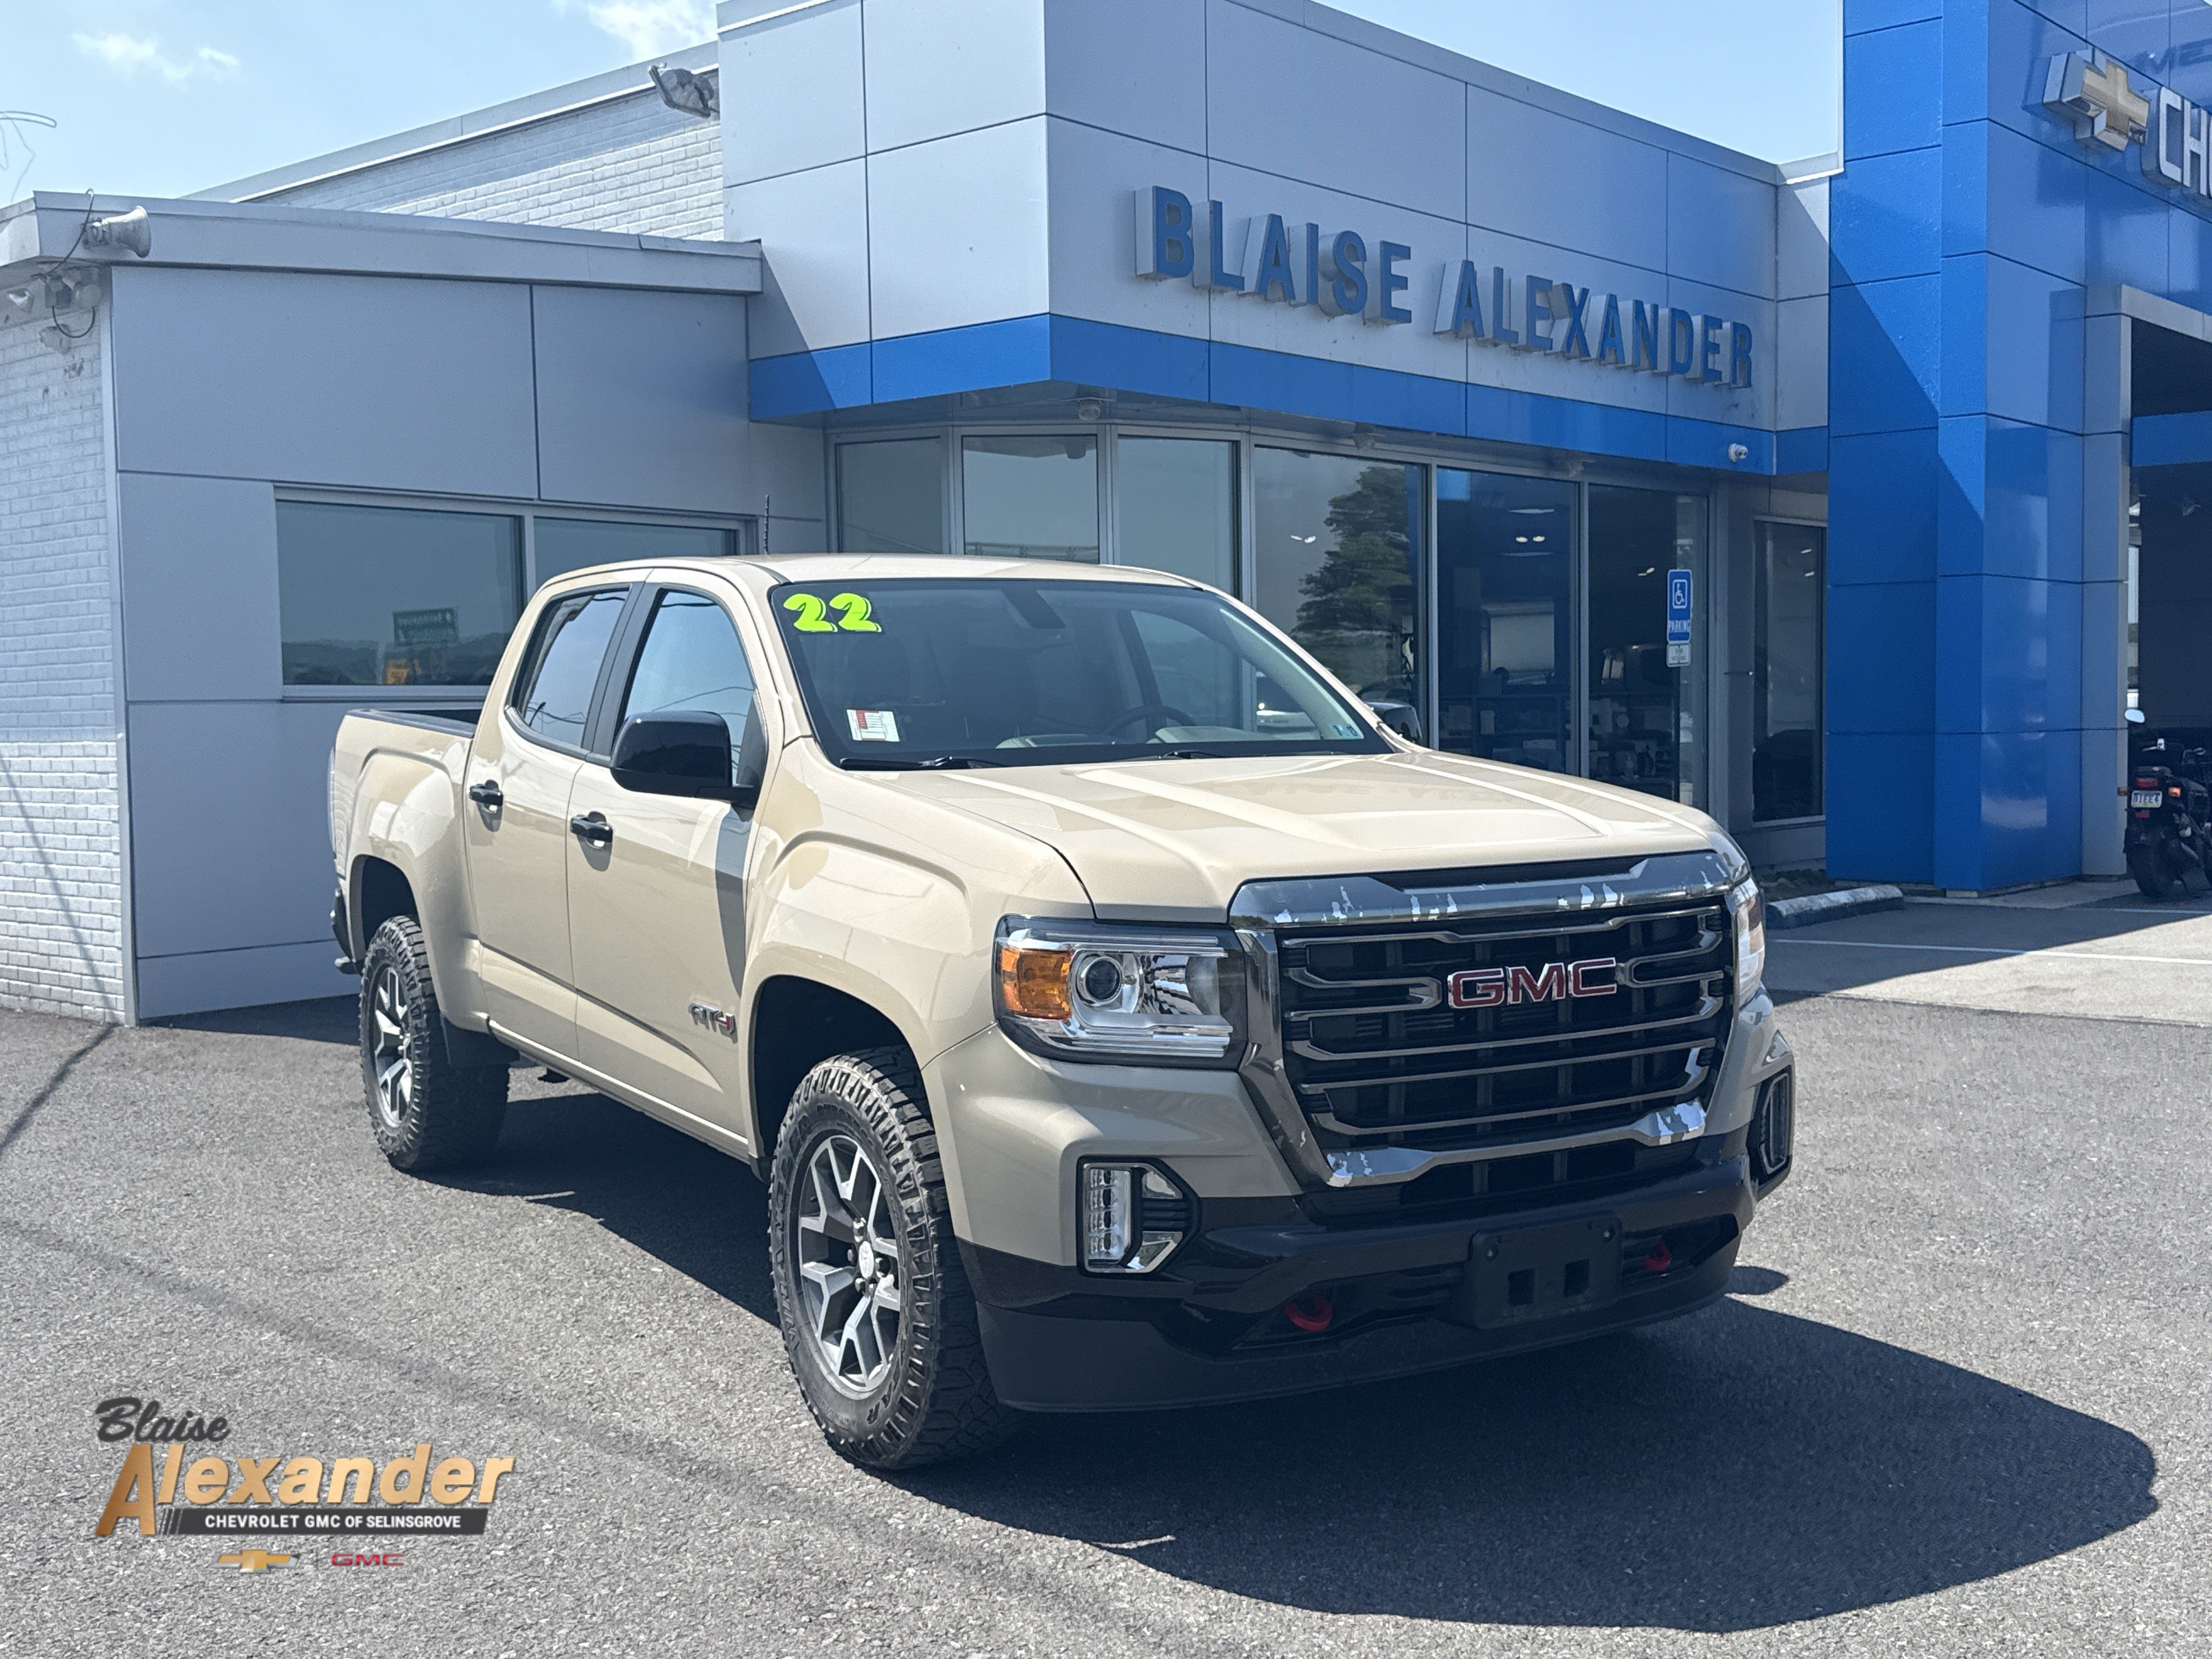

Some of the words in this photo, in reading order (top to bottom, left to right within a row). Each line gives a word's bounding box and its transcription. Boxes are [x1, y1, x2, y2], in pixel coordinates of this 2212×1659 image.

[2159, 87, 2212, 197] CH
[1140, 185, 1412, 324] BLAISE
[1442, 259, 1753, 388] ALEXANDER
[783, 593, 882, 632] 22
[1448, 957, 1617, 1008] GMC
